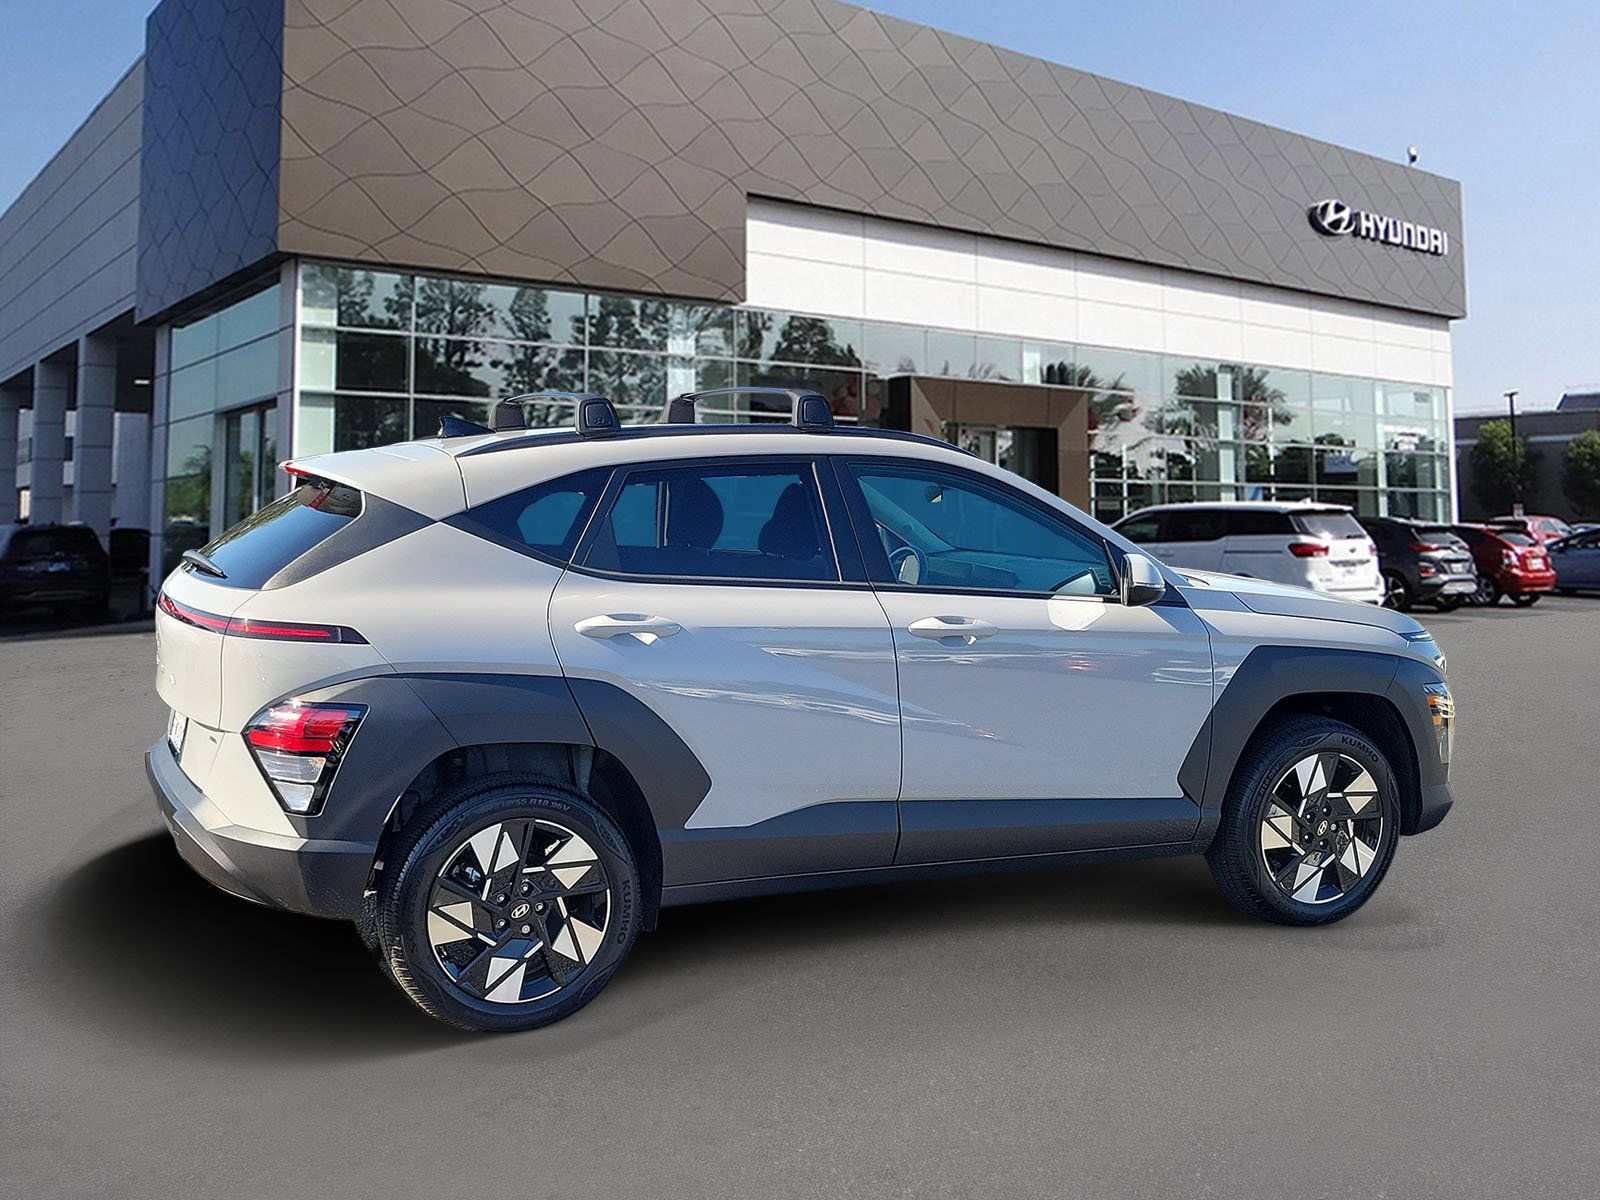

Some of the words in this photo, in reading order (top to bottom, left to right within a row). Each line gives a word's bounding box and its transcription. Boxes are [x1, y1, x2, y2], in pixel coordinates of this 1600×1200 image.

[1360, 211, 1449, 256] HYUNDAI
[1341, 736, 1379, 763] KUMHO
[617, 880, 632, 945] KUMHO
